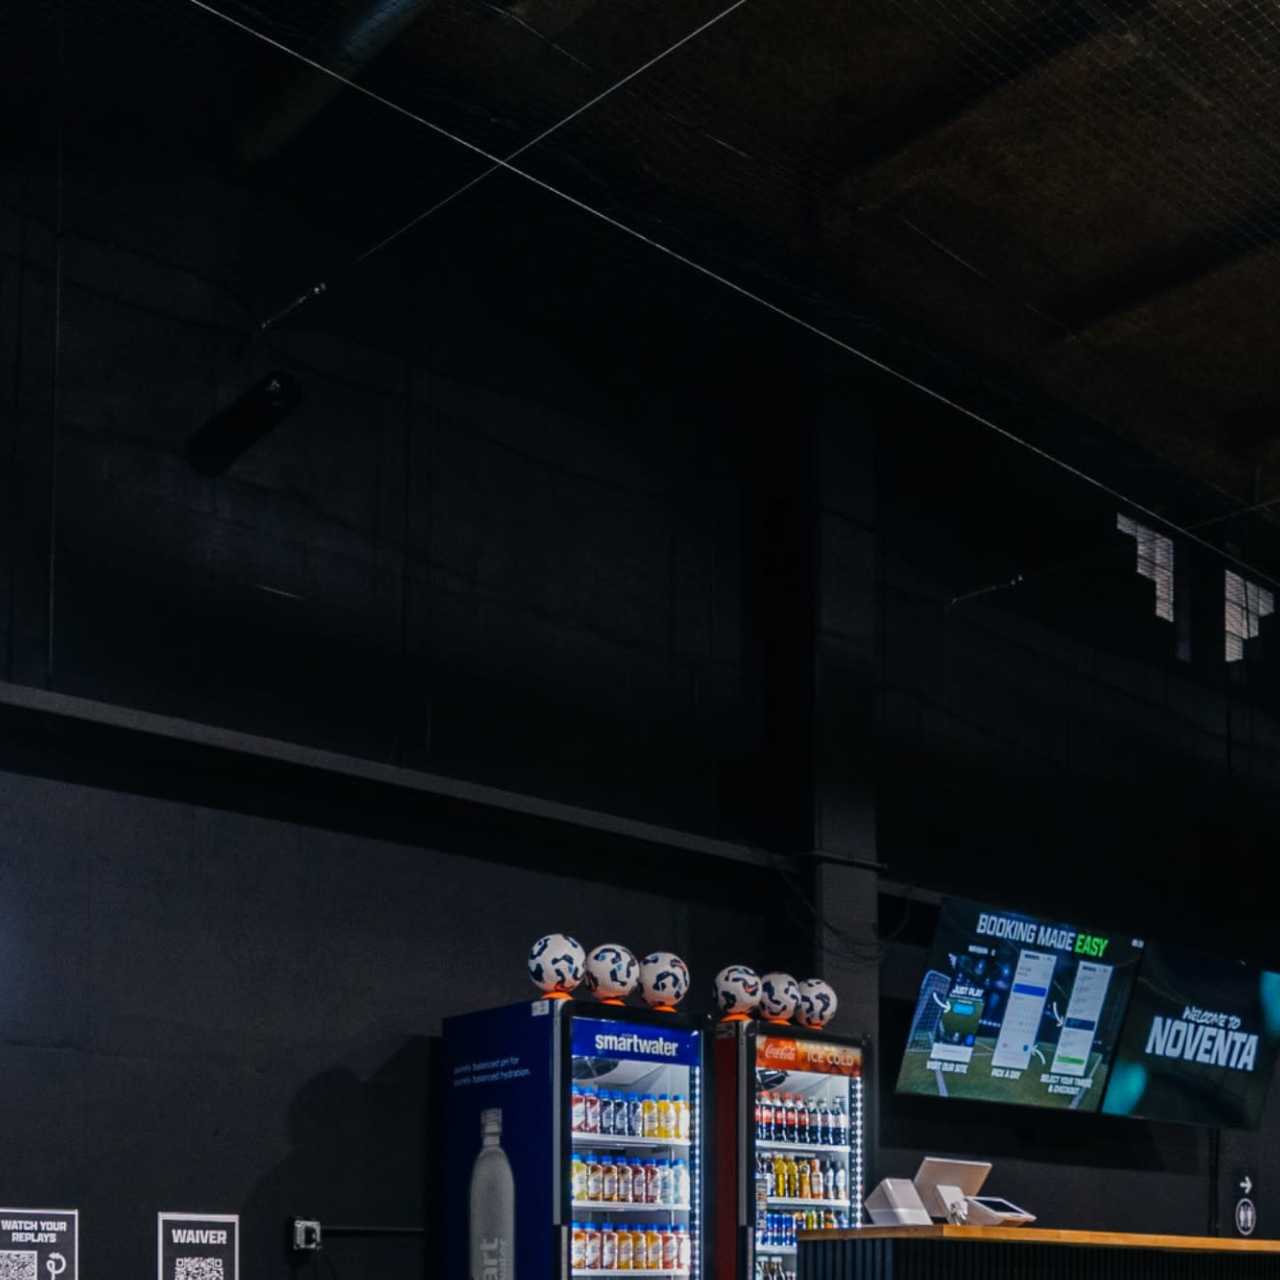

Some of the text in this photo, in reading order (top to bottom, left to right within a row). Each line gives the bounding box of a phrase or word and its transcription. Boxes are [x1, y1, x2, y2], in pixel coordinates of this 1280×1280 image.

[976, 913, 1108, 957] BOOKING MADE EASY
[595, 1034, 679, 1057] smartwater
[1145, 1016, 1259, 1071] NOVENTA
[806, 1050, 854, 1067] ICE COLD
[0, 1220, 67, 1232] WATCH YOUR
[11, 1232, 57, 1243] REPLAYS
[172, 1228, 227, 1245] WAIVER
